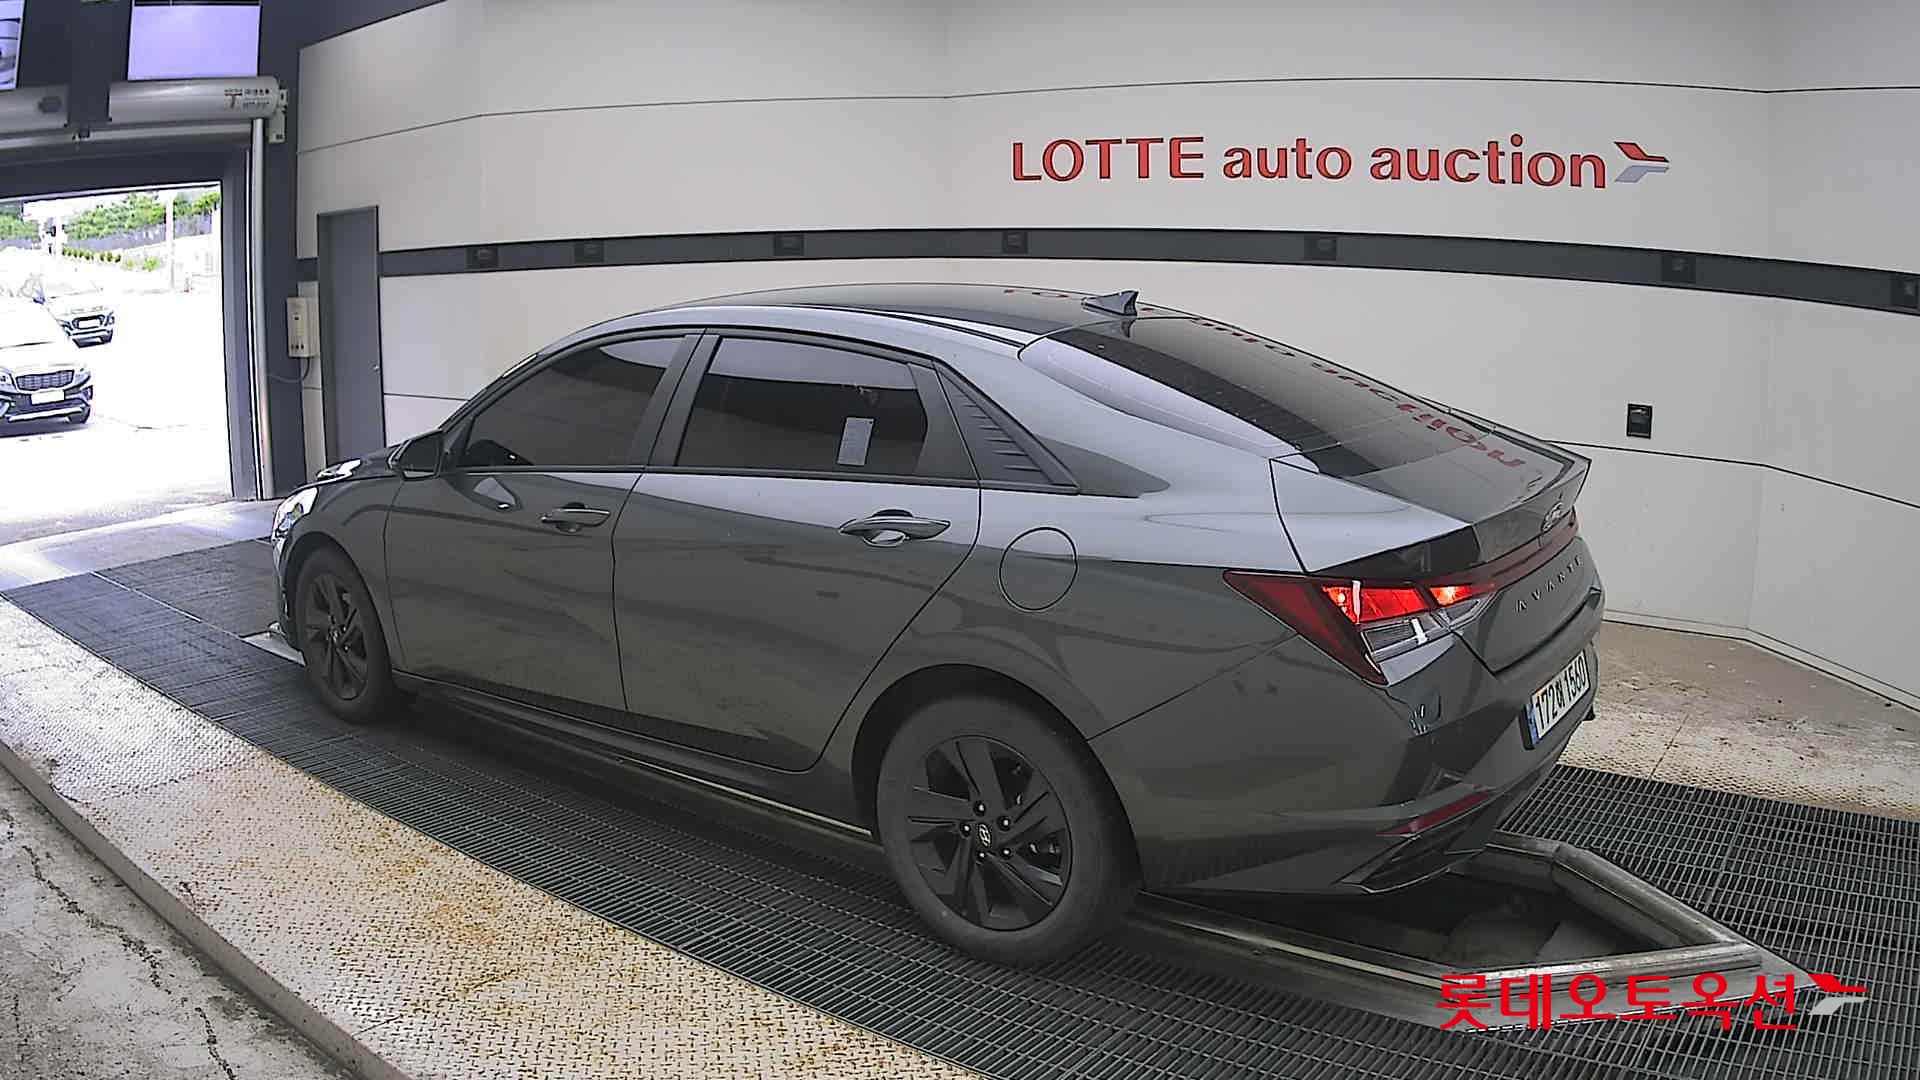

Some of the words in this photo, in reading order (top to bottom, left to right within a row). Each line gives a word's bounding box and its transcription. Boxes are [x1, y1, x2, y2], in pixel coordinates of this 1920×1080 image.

[1012, 136, 1204, 182] LOTTE
[1222, 138, 1352, 180] auto
[1369, 134, 1607, 189] auction
